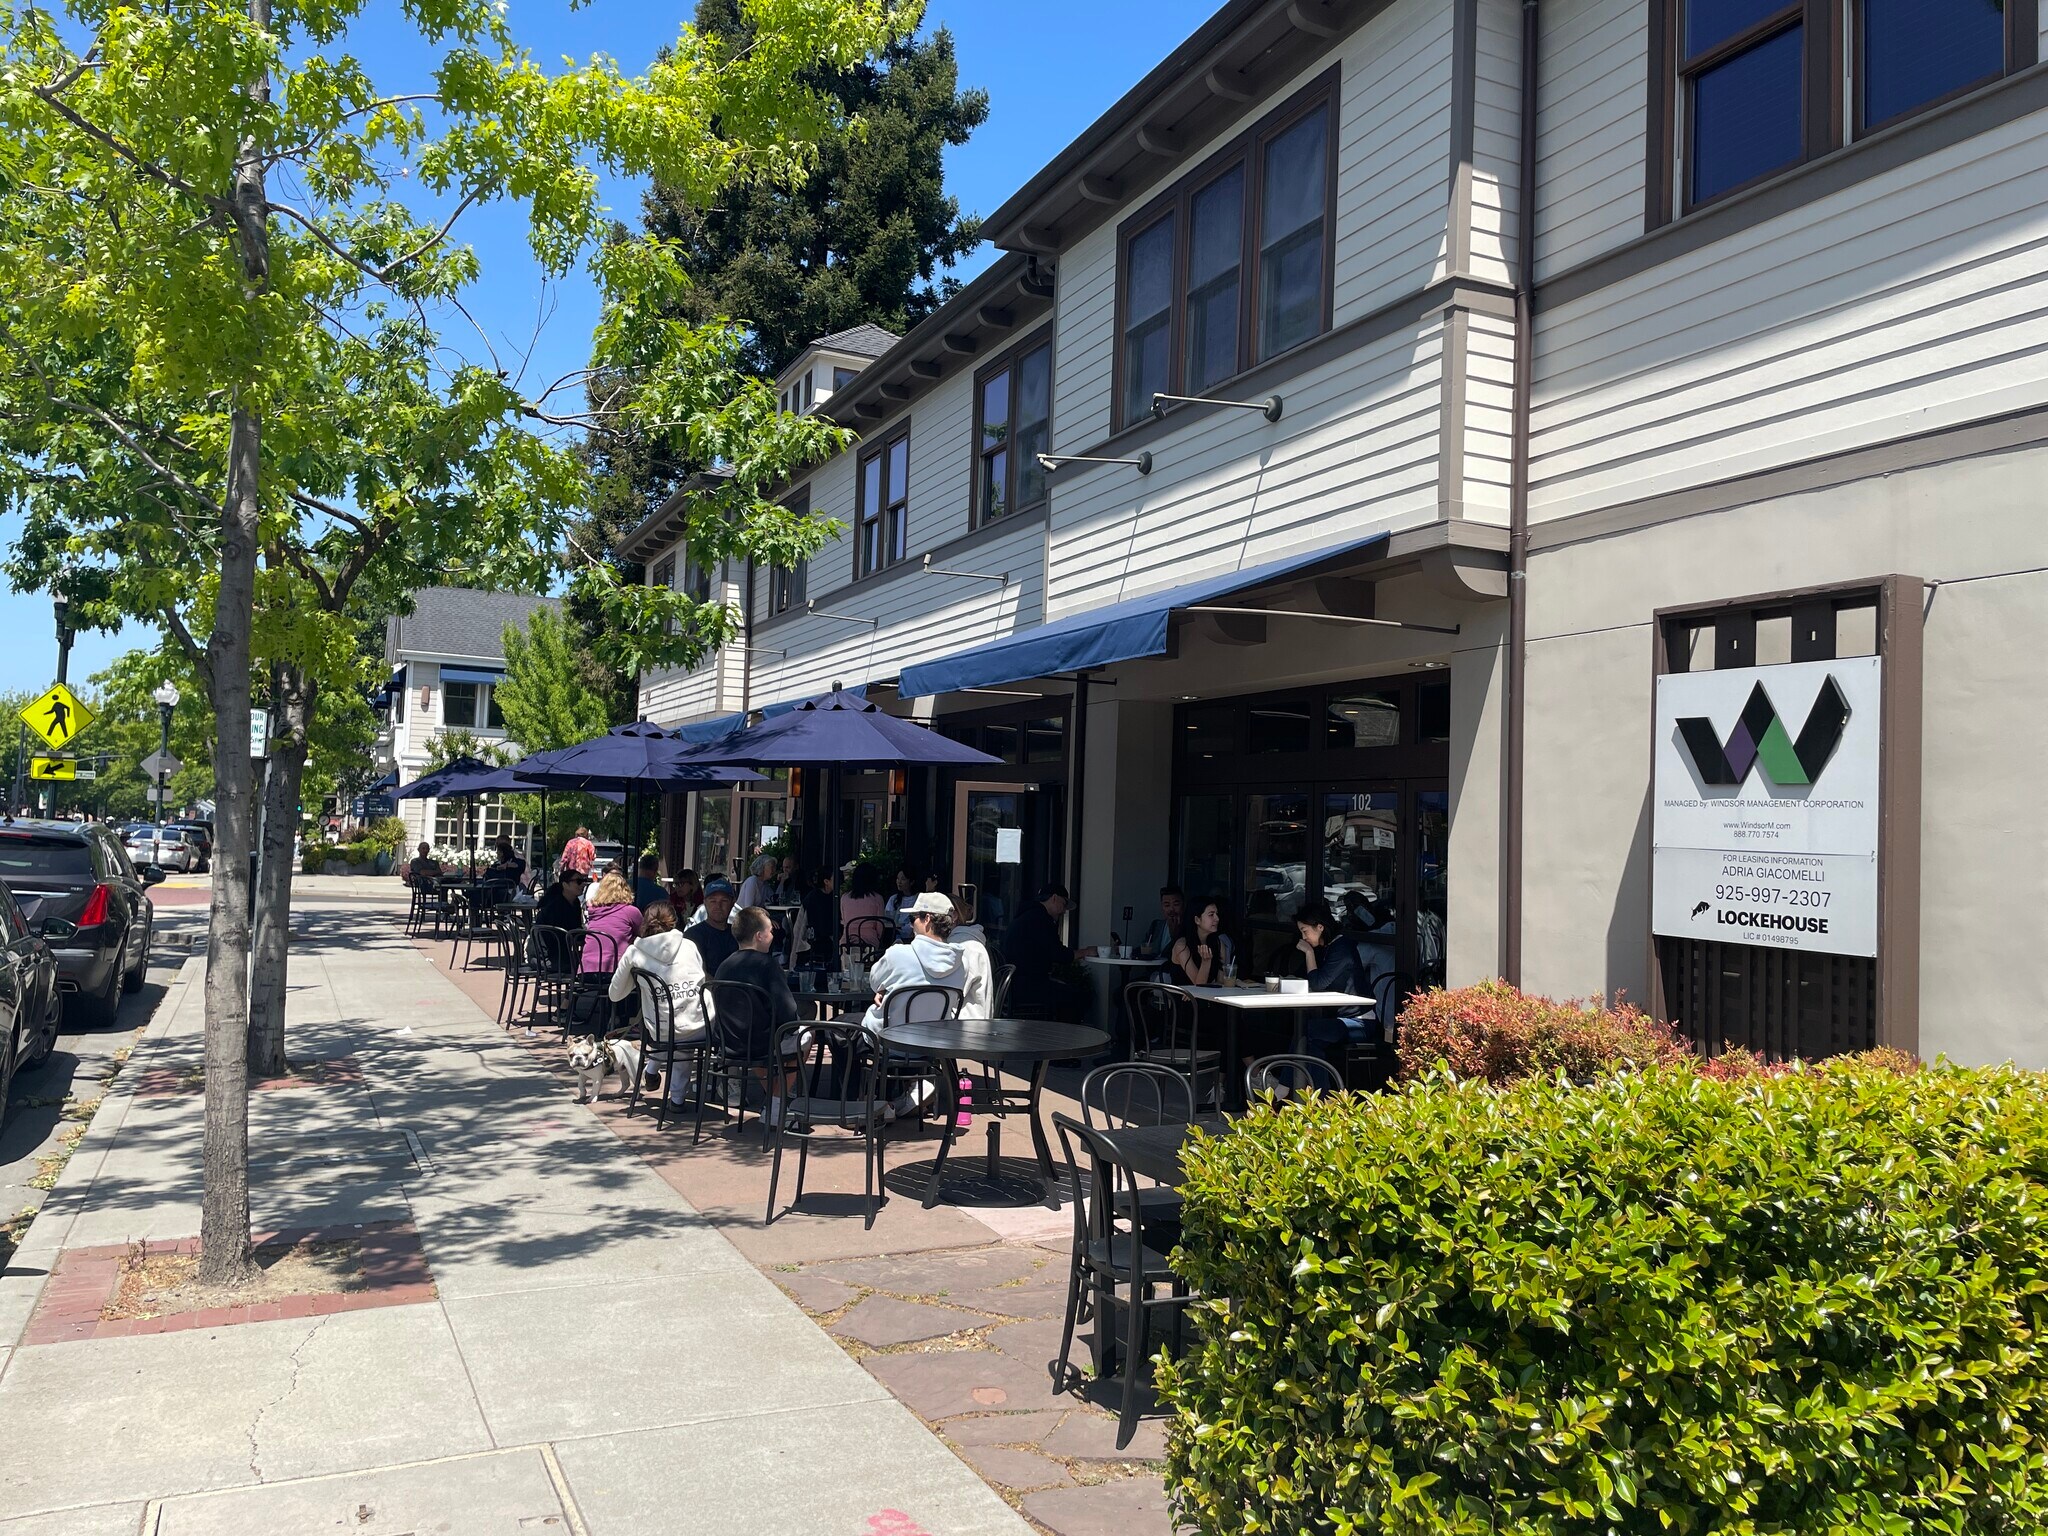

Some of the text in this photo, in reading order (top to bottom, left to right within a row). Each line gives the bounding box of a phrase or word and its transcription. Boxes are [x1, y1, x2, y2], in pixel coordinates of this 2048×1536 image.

[1352, 793, 1371, 811] 102
[1664, 799, 1864, 809] MANAGED by: WINDSOR MANAGEMENT CORPORATION
[1722, 821, 1791, 830] www.WindsorM.com
[1723, 854, 1824, 867] FOR LEASING INFORMATION
[1721, 865, 1825, 882] ADRIA GIACOMELLI
[1715, 884, 1832, 908] 925-997-2307
[1717, 909, 1829, 934] LOCKEHOUSE
[1743, 932, 1755, 940] LIC
[1761, 934, 1799, 945] 01498795
[682, 980, 695, 990] OF
